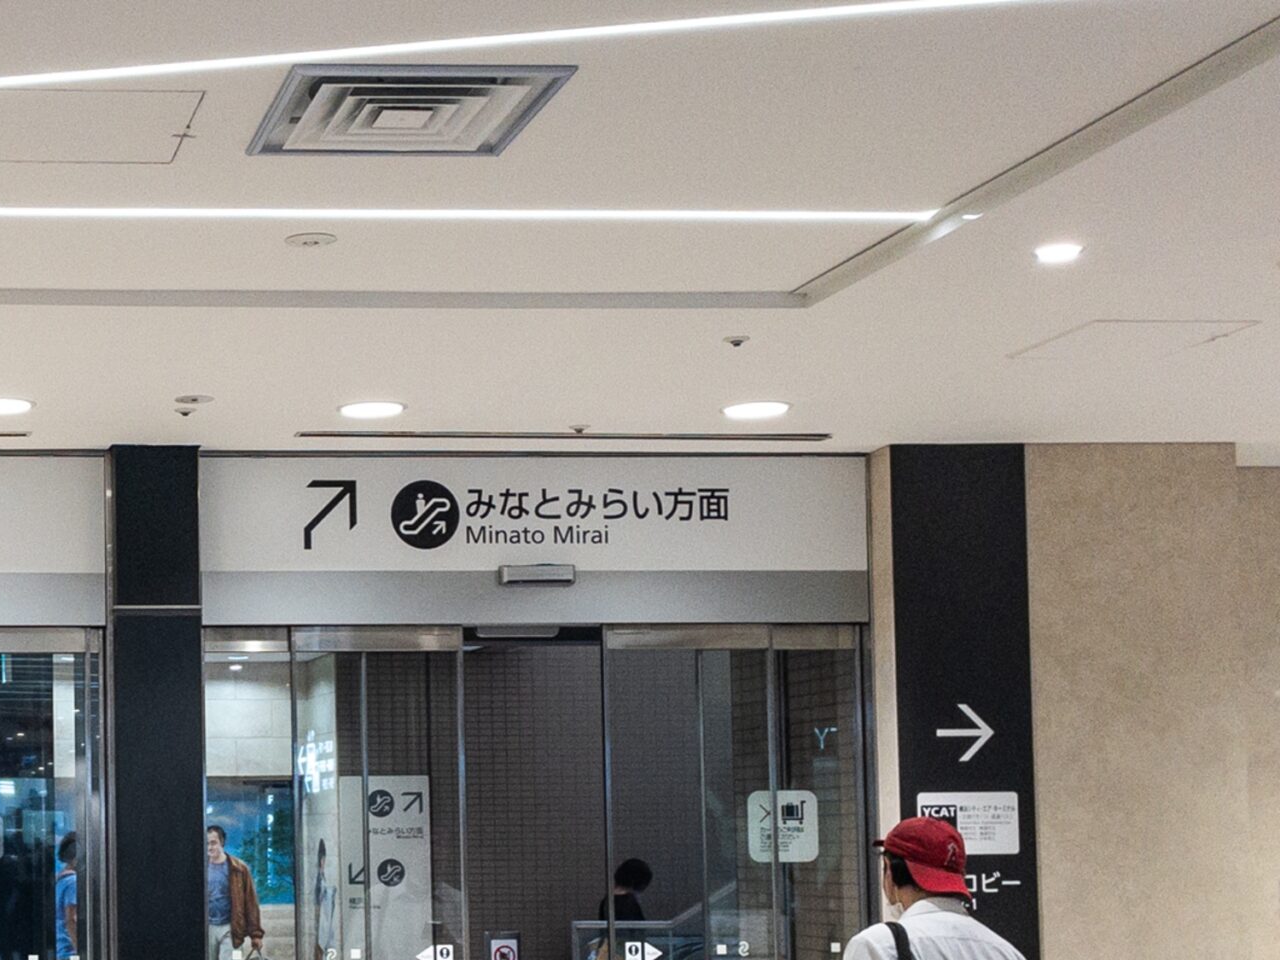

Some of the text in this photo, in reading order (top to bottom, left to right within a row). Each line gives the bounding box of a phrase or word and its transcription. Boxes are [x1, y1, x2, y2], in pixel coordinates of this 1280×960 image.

[465, 487, 730, 521] みなとみらい方面
[465, 525, 609, 545] Minato Mirai
[922, 806, 956, 818] YCAT
